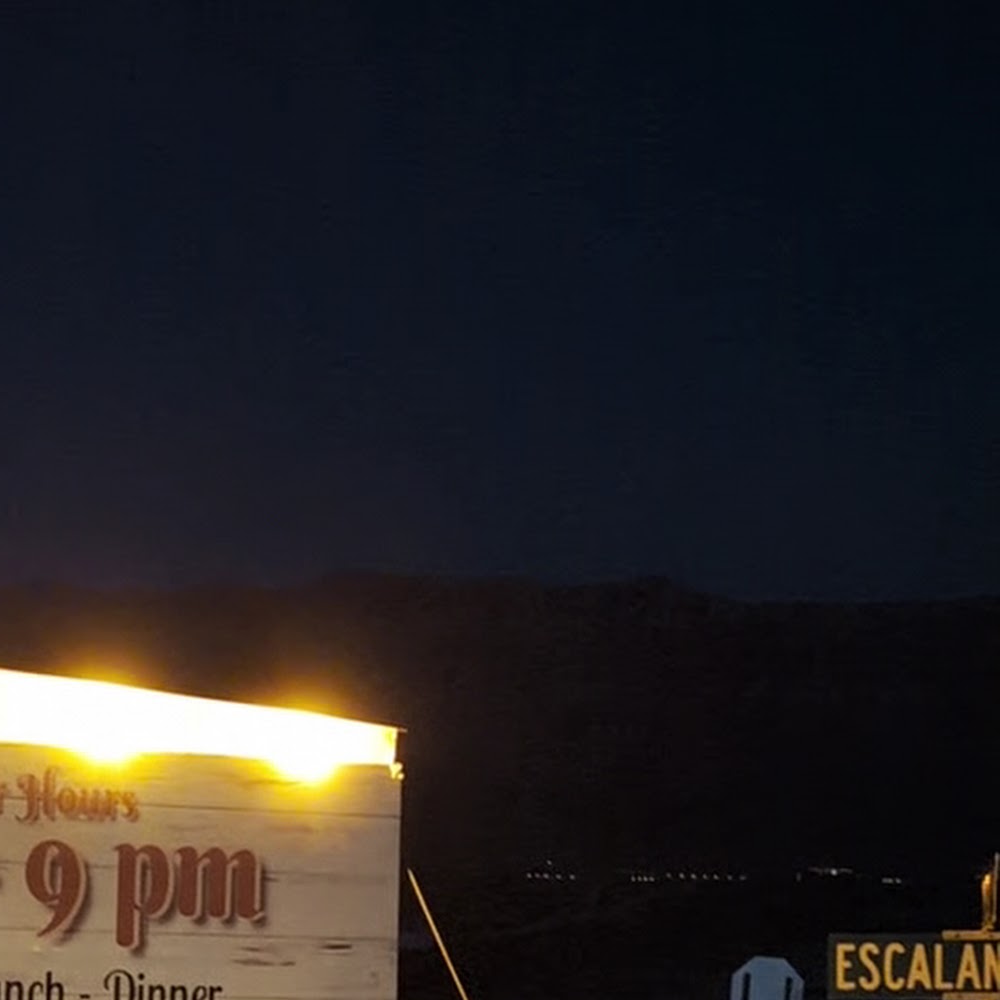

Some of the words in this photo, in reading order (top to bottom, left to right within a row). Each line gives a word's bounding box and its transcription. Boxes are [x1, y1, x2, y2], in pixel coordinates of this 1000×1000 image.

[14, 767, 139, 822] Hours
[25, 839, 94, 942] 9
[113, 842, 268, 956] pm
[835, 942, 1000, 991] ESCALAN
